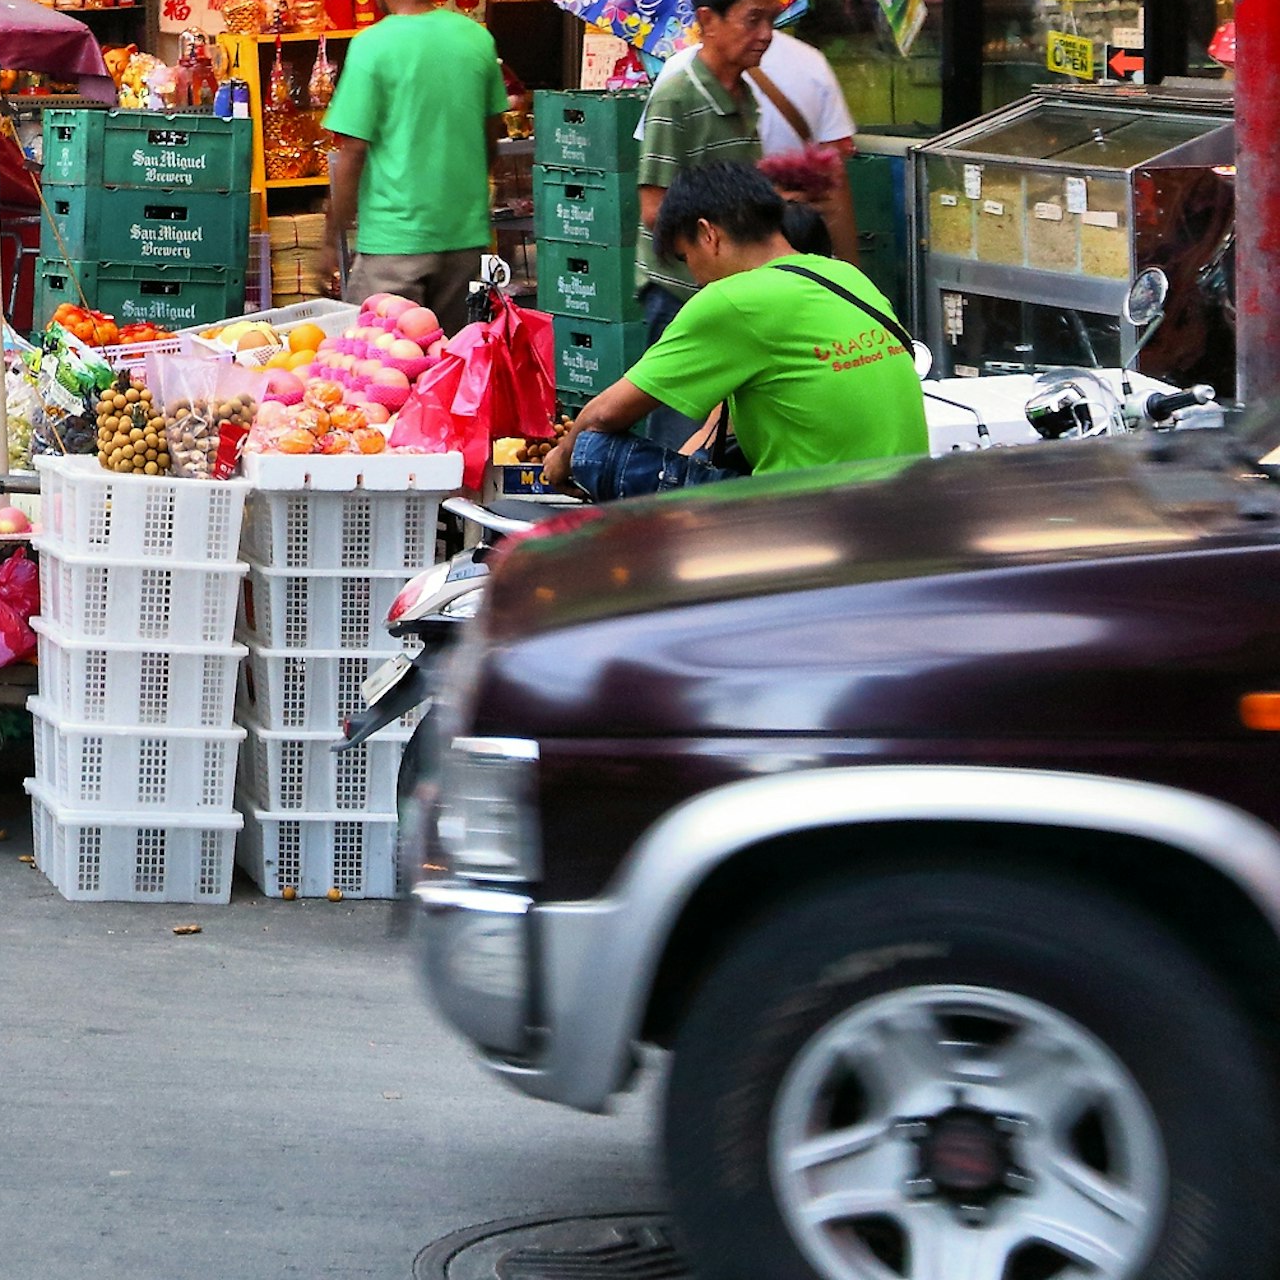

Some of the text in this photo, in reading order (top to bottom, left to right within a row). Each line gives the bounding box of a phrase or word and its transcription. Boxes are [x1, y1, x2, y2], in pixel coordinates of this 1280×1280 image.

[132, 149, 206, 170] San Miguel
[145, 167, 193, 185] Brewery
[130, 223, 203, 244] San Miguel
[141, 241, 191, 260] Brewery
[122, 299, 196, 320] San Miguel
[832, 350, 883, 372] Seafood
